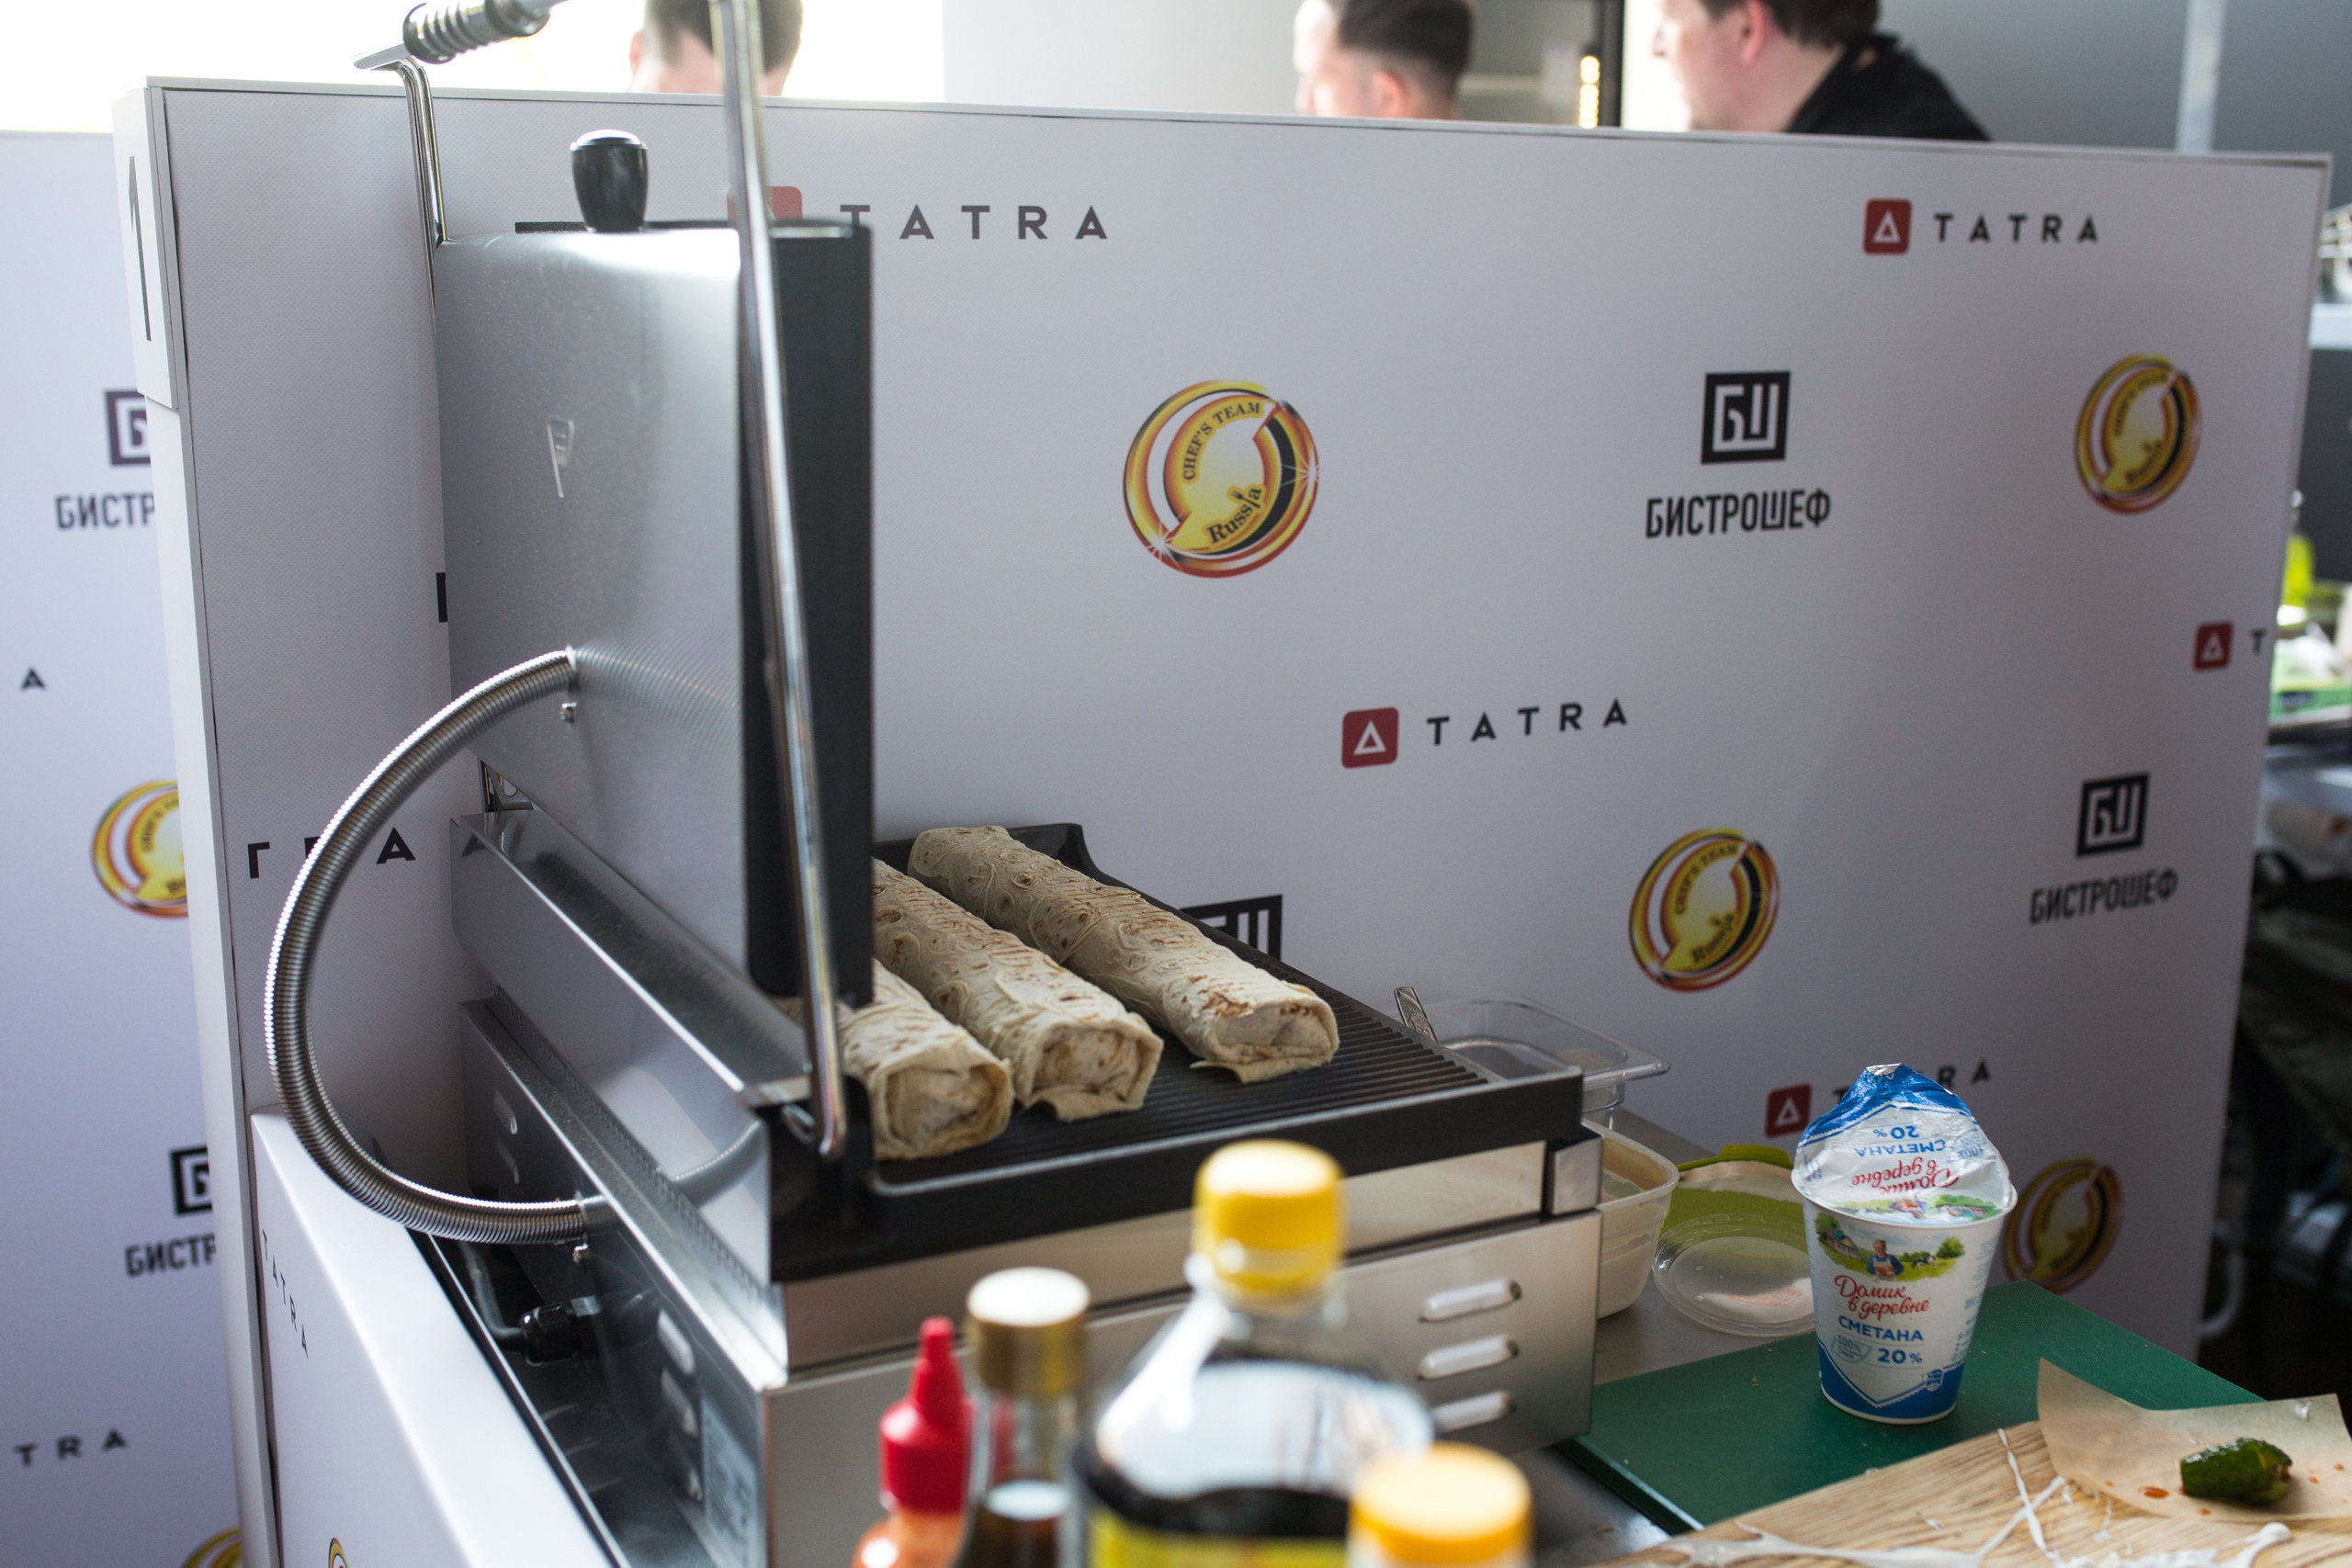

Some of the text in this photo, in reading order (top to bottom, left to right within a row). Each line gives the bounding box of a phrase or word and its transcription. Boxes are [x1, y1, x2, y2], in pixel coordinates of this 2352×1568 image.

[840, 204, 1108, 240] TATRA
[1934, 212, 2098, 243] TATRA
[1182, 401, 1261, 480] CHEF'S TEAM
[54, 491, 155, 530] БИСТР
[1645, 488, 1832, 539] БИСТРОШЕФ
[1426, 697, 1628, 747] TATRA
[2029, 867, 2178, 925] БИСТРОШЕФ
[1853, 1139, 1947, 1157] СМЕТАНА
[262, 1228, 309, 1359] TATRA
[1834, 1275, 1906, 1298] Домик
[1847, 1295, 1930, 1322] в деревне
[1838, 1315, 1924, 1342] СМЕТАНА
[12, 1427, 129, 1468] TRA
